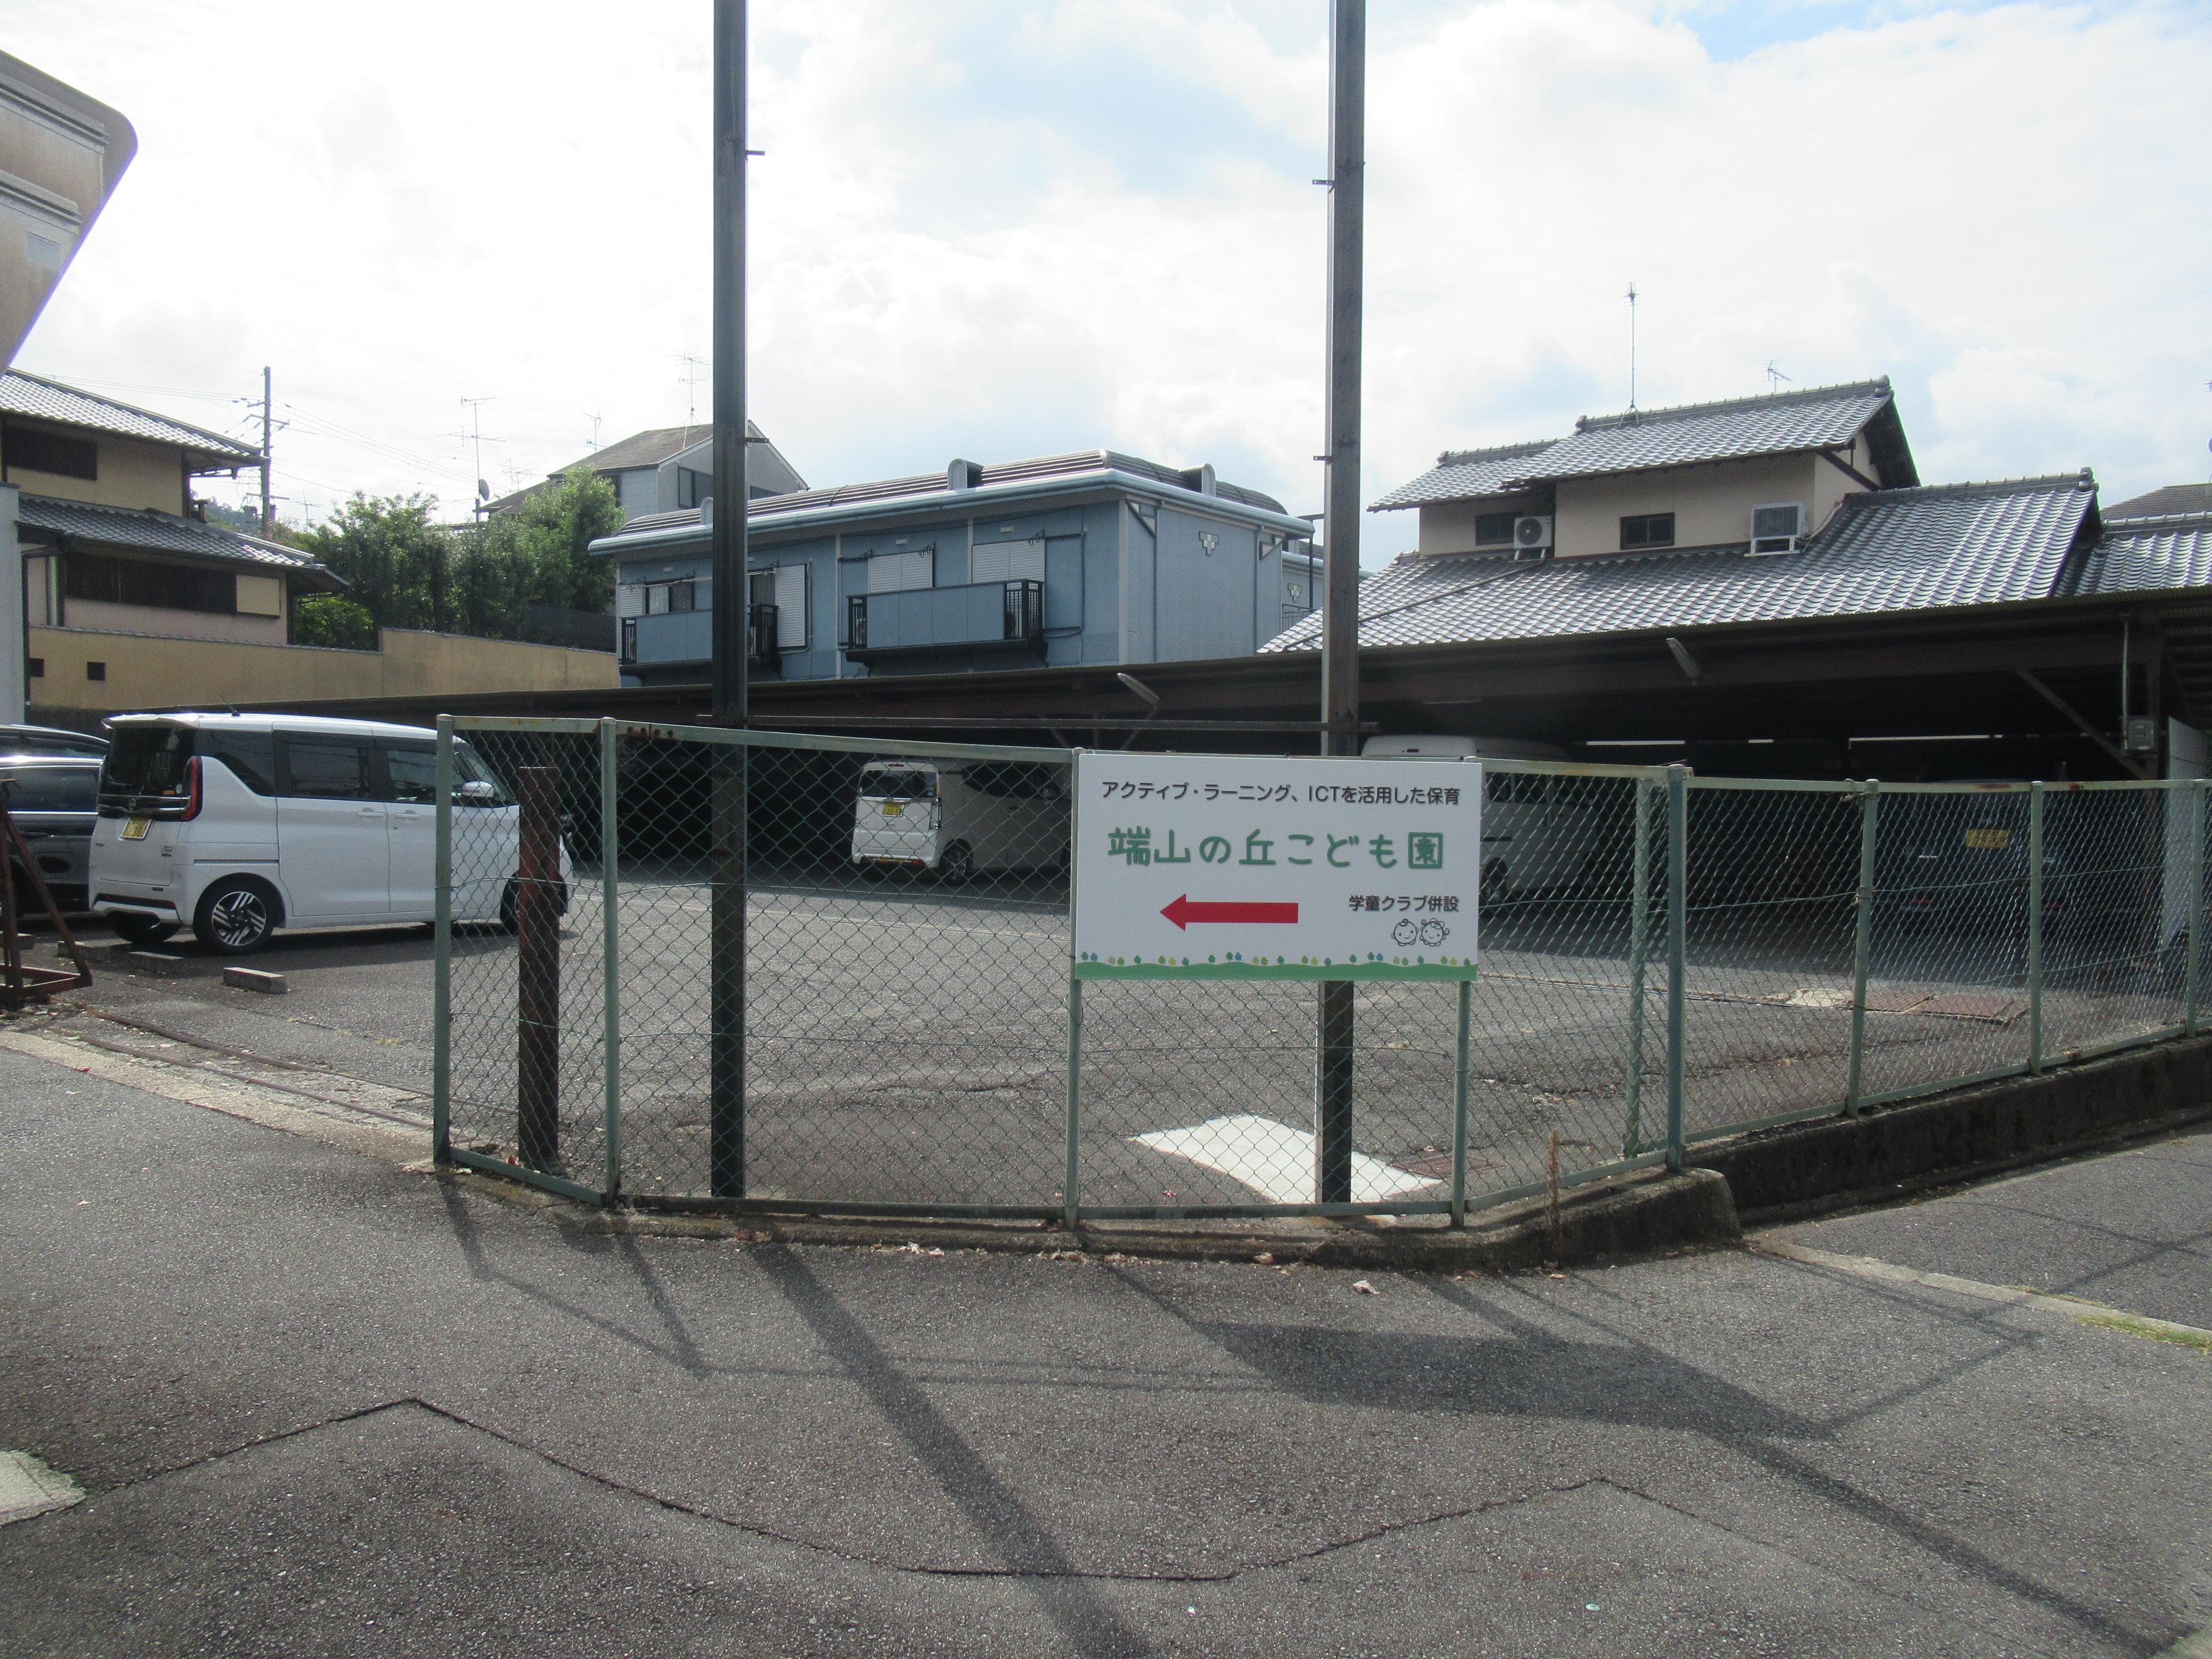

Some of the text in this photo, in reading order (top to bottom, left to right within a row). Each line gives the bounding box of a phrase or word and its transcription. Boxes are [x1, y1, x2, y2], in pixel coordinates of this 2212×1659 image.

[1101, 781, 1461, 805] アクティブ・ラーニング、ICTを活用した保育
[1107, 825, 1444, 869] 端山の丘こども園
[1348, 895, 1459, 912] 学童クラブ併設
